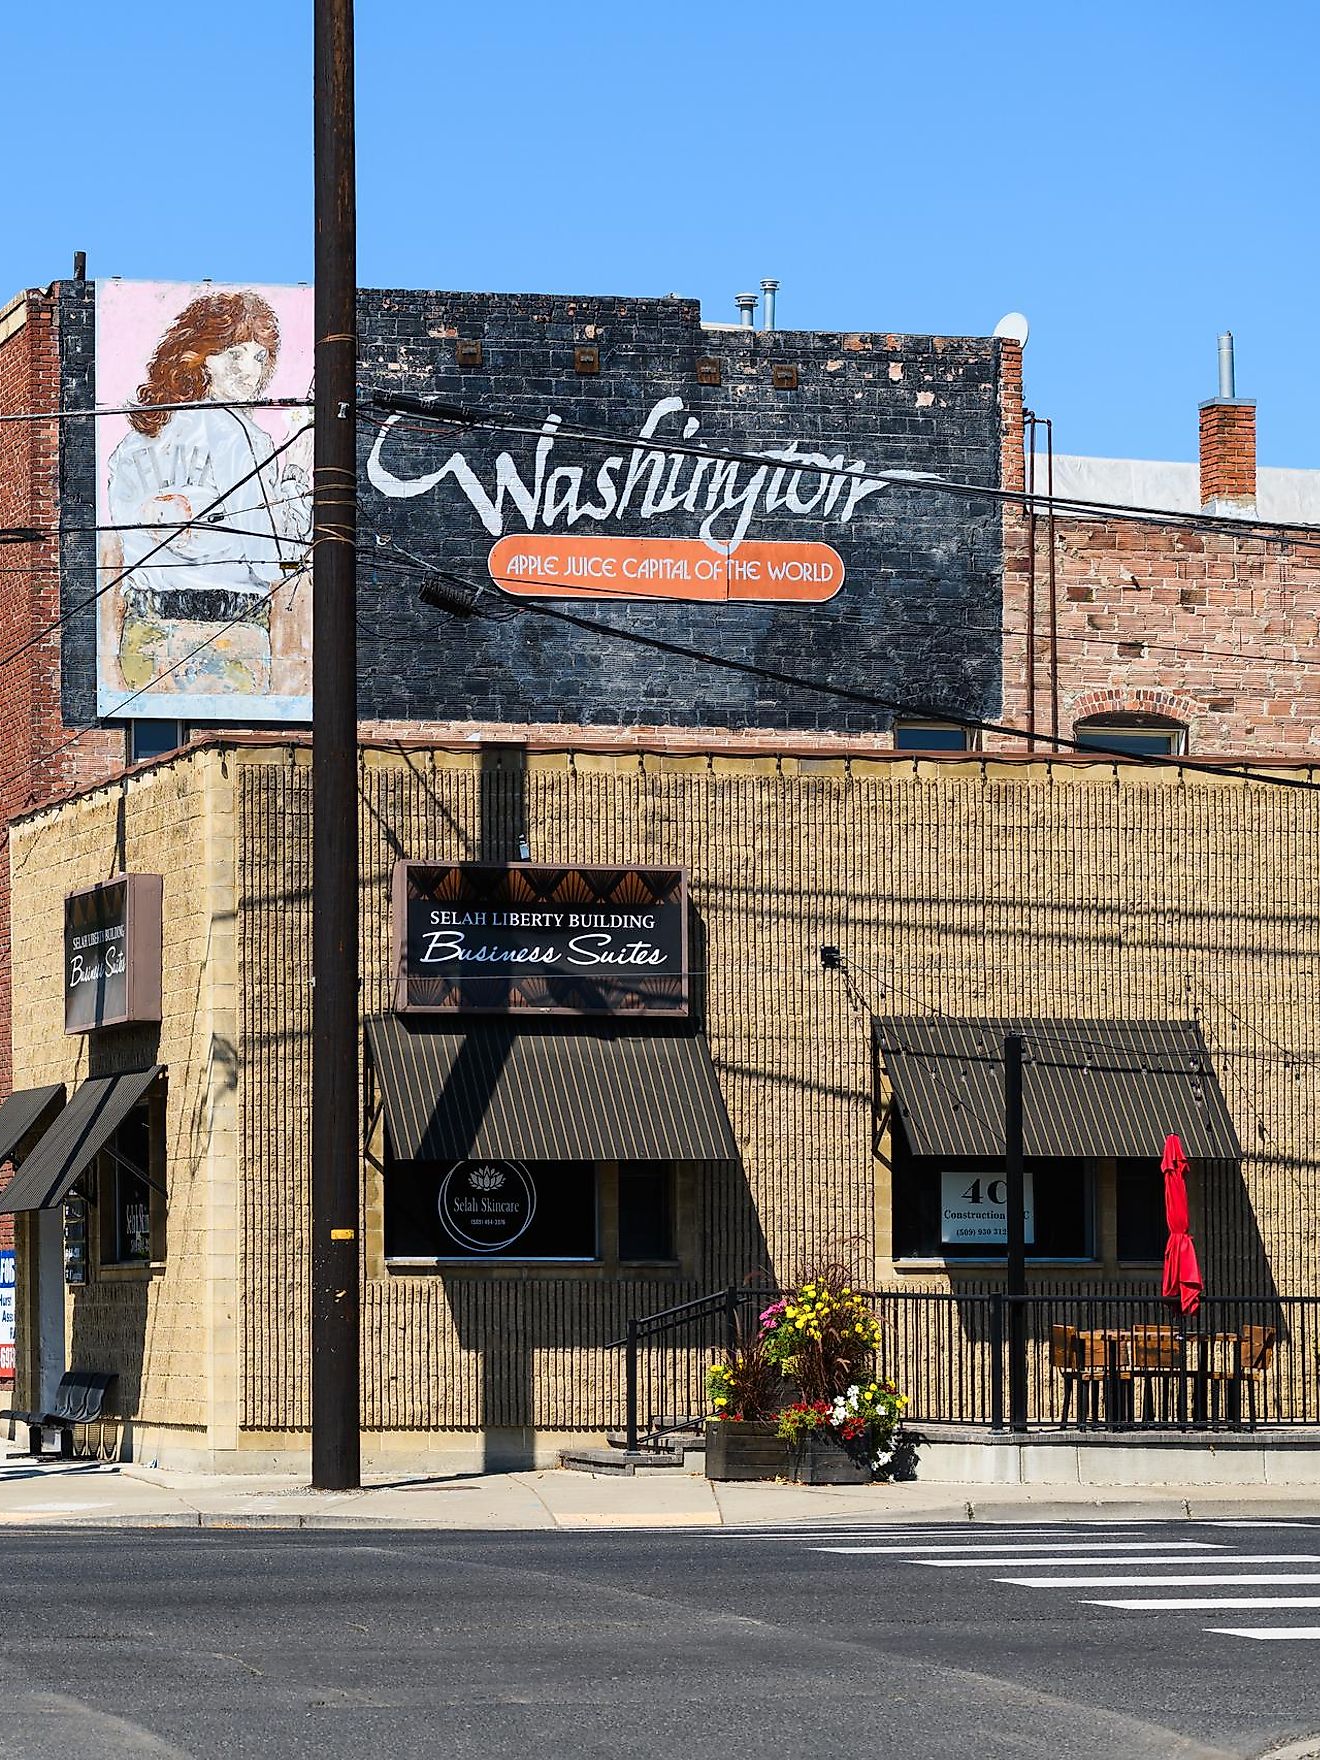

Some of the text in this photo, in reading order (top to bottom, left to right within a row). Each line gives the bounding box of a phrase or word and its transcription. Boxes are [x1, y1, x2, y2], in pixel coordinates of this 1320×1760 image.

[367, 397, 942, 554] Washington
[506, 554, 834, 582] APPLE JUICE CAPITAL OF THE WORLD
[430, 910, 656, 929] SELAH LIBERTY BUILDING
[420, 930, 669, 966] Business Suites
[453, 1197, 520, 1213] Selah Skincare
[944, 1209, 1006, 1220] Construction
